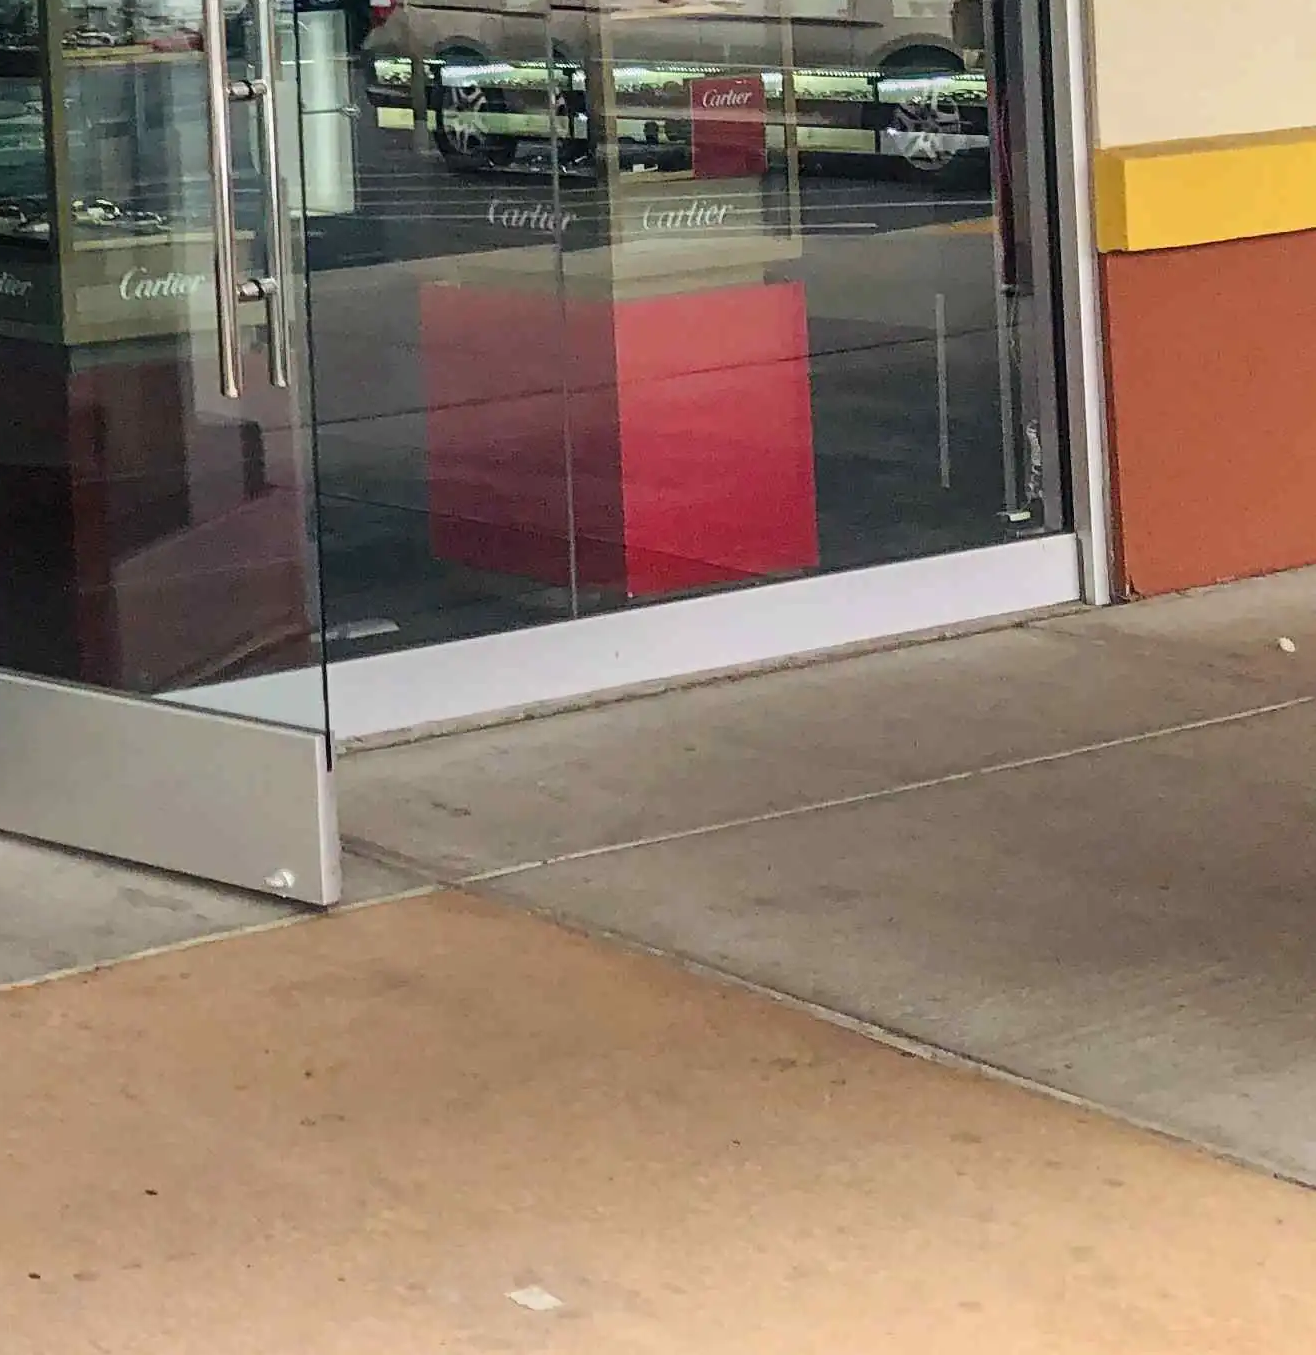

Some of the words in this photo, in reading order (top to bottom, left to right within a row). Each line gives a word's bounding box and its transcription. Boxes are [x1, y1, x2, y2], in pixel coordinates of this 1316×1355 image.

[702, 88, 752, 110] Cartier
[643, 199, 733, 230] Cartier
[119, 266, 206, 300] Cartier
